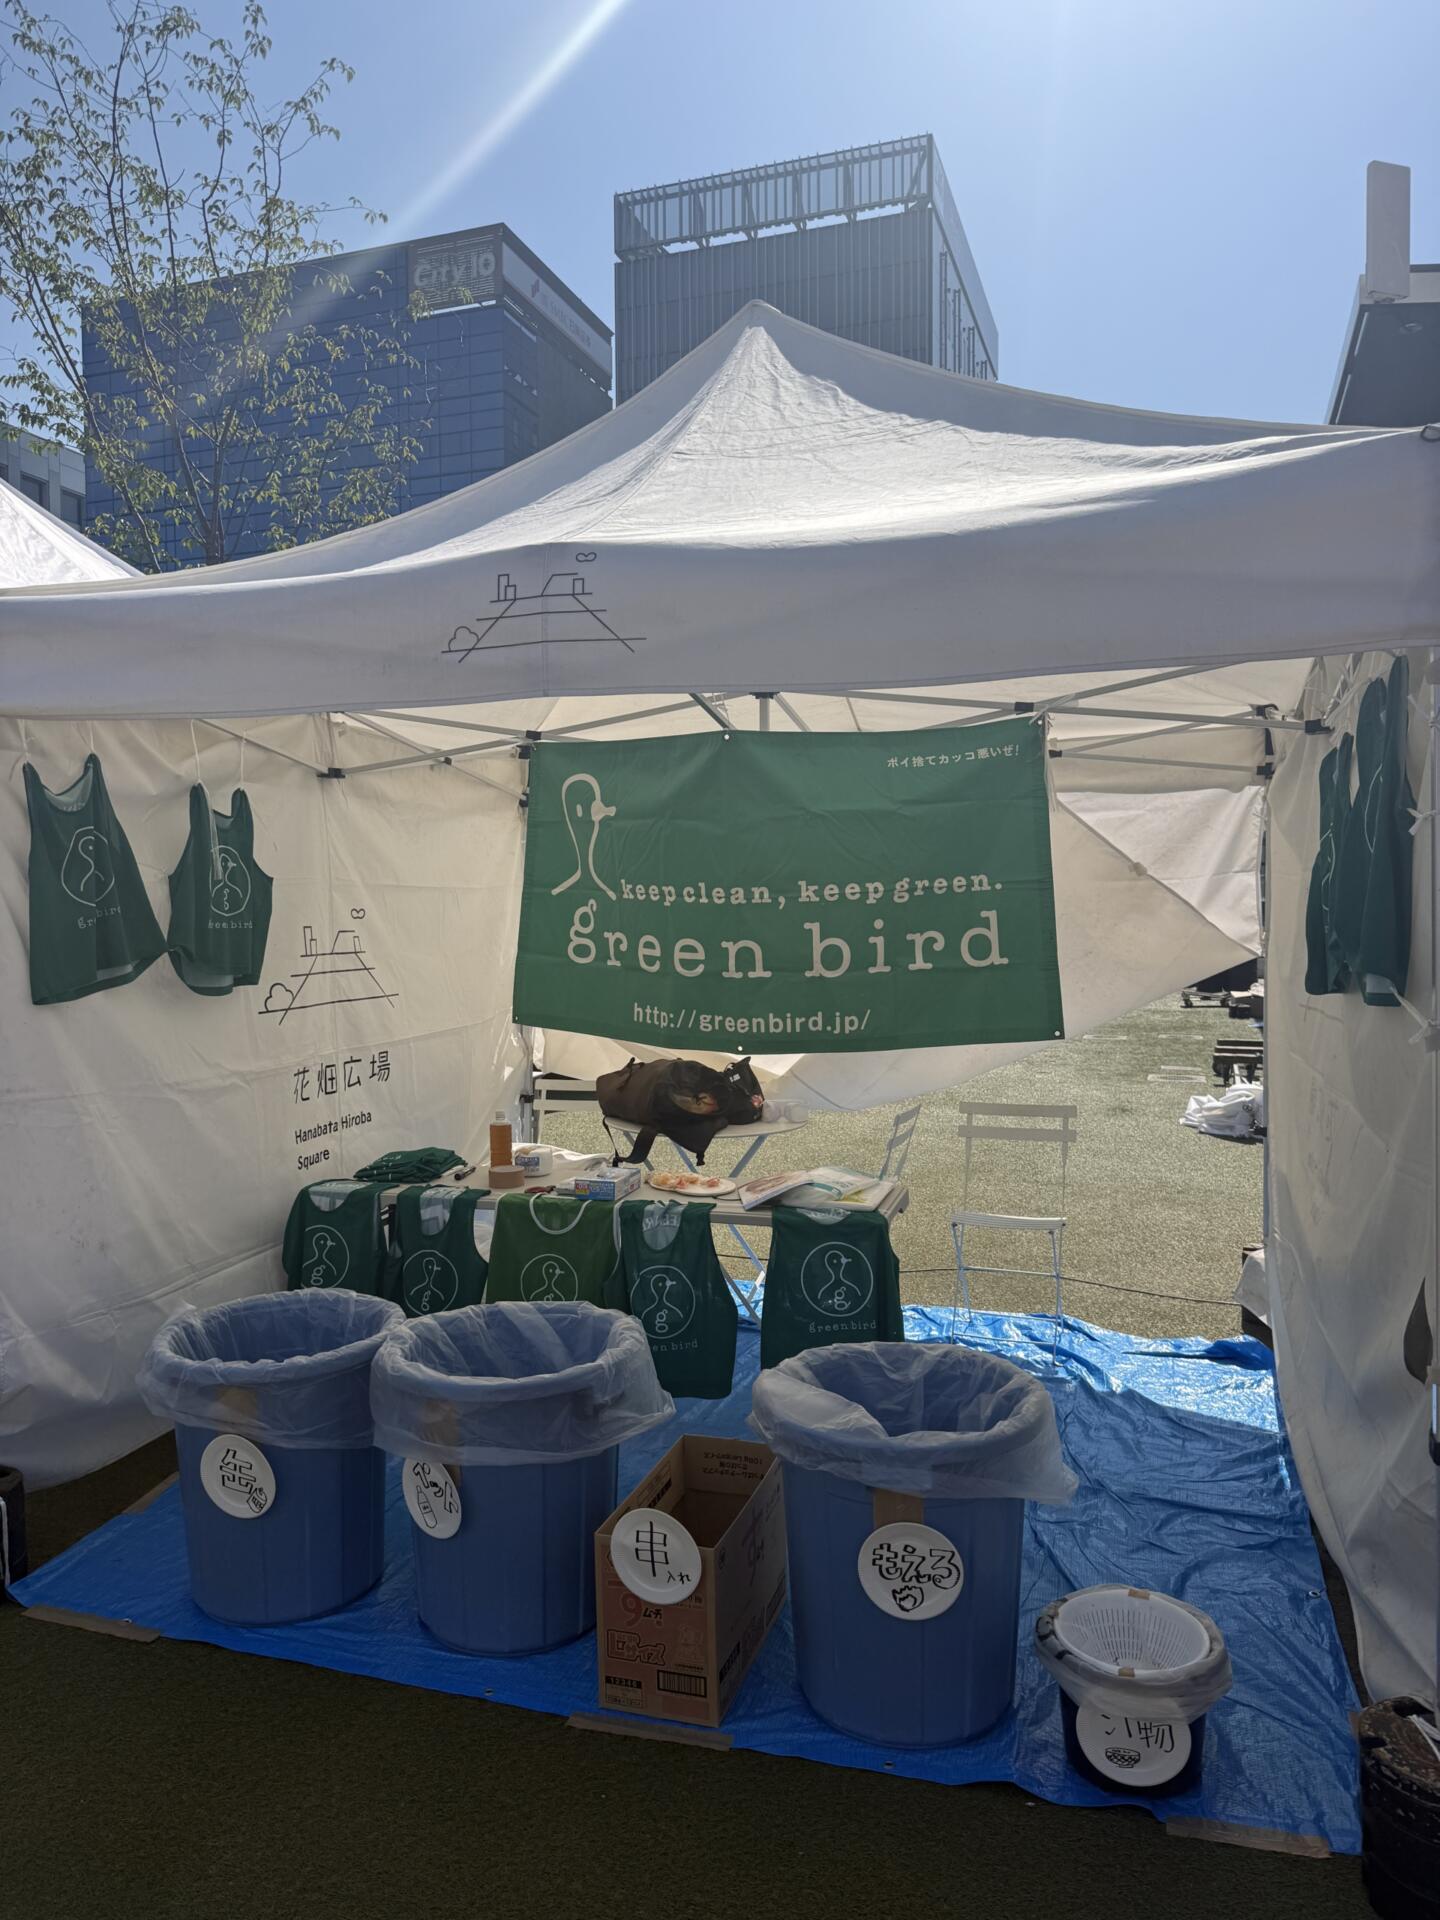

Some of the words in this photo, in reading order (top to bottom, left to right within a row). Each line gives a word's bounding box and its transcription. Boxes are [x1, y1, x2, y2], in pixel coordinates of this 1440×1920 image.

[620, 879, 676, 907] keep
[683, 881, 786, 910] clean,
[798, 880, 884, 905] keep
[893, 873, 1003, 904] green.
[566, 898, 772, 979] green
[803, 909, 1009, 979] bird
[632, 1001, 872, 1035] http://greenbird.jp/
[294, 1050, 391, 1104] 花畑広場
[294, 1120, 338, 1145] Hanabata
[341, 1111, 372, 1129] Hiroba
[297, 1149, 330, 1171] Square
[808, 1320, 848, 1334] green
[851, 1319, 877, 1330] bird
[871, 1541, 962, 1590] もえる
